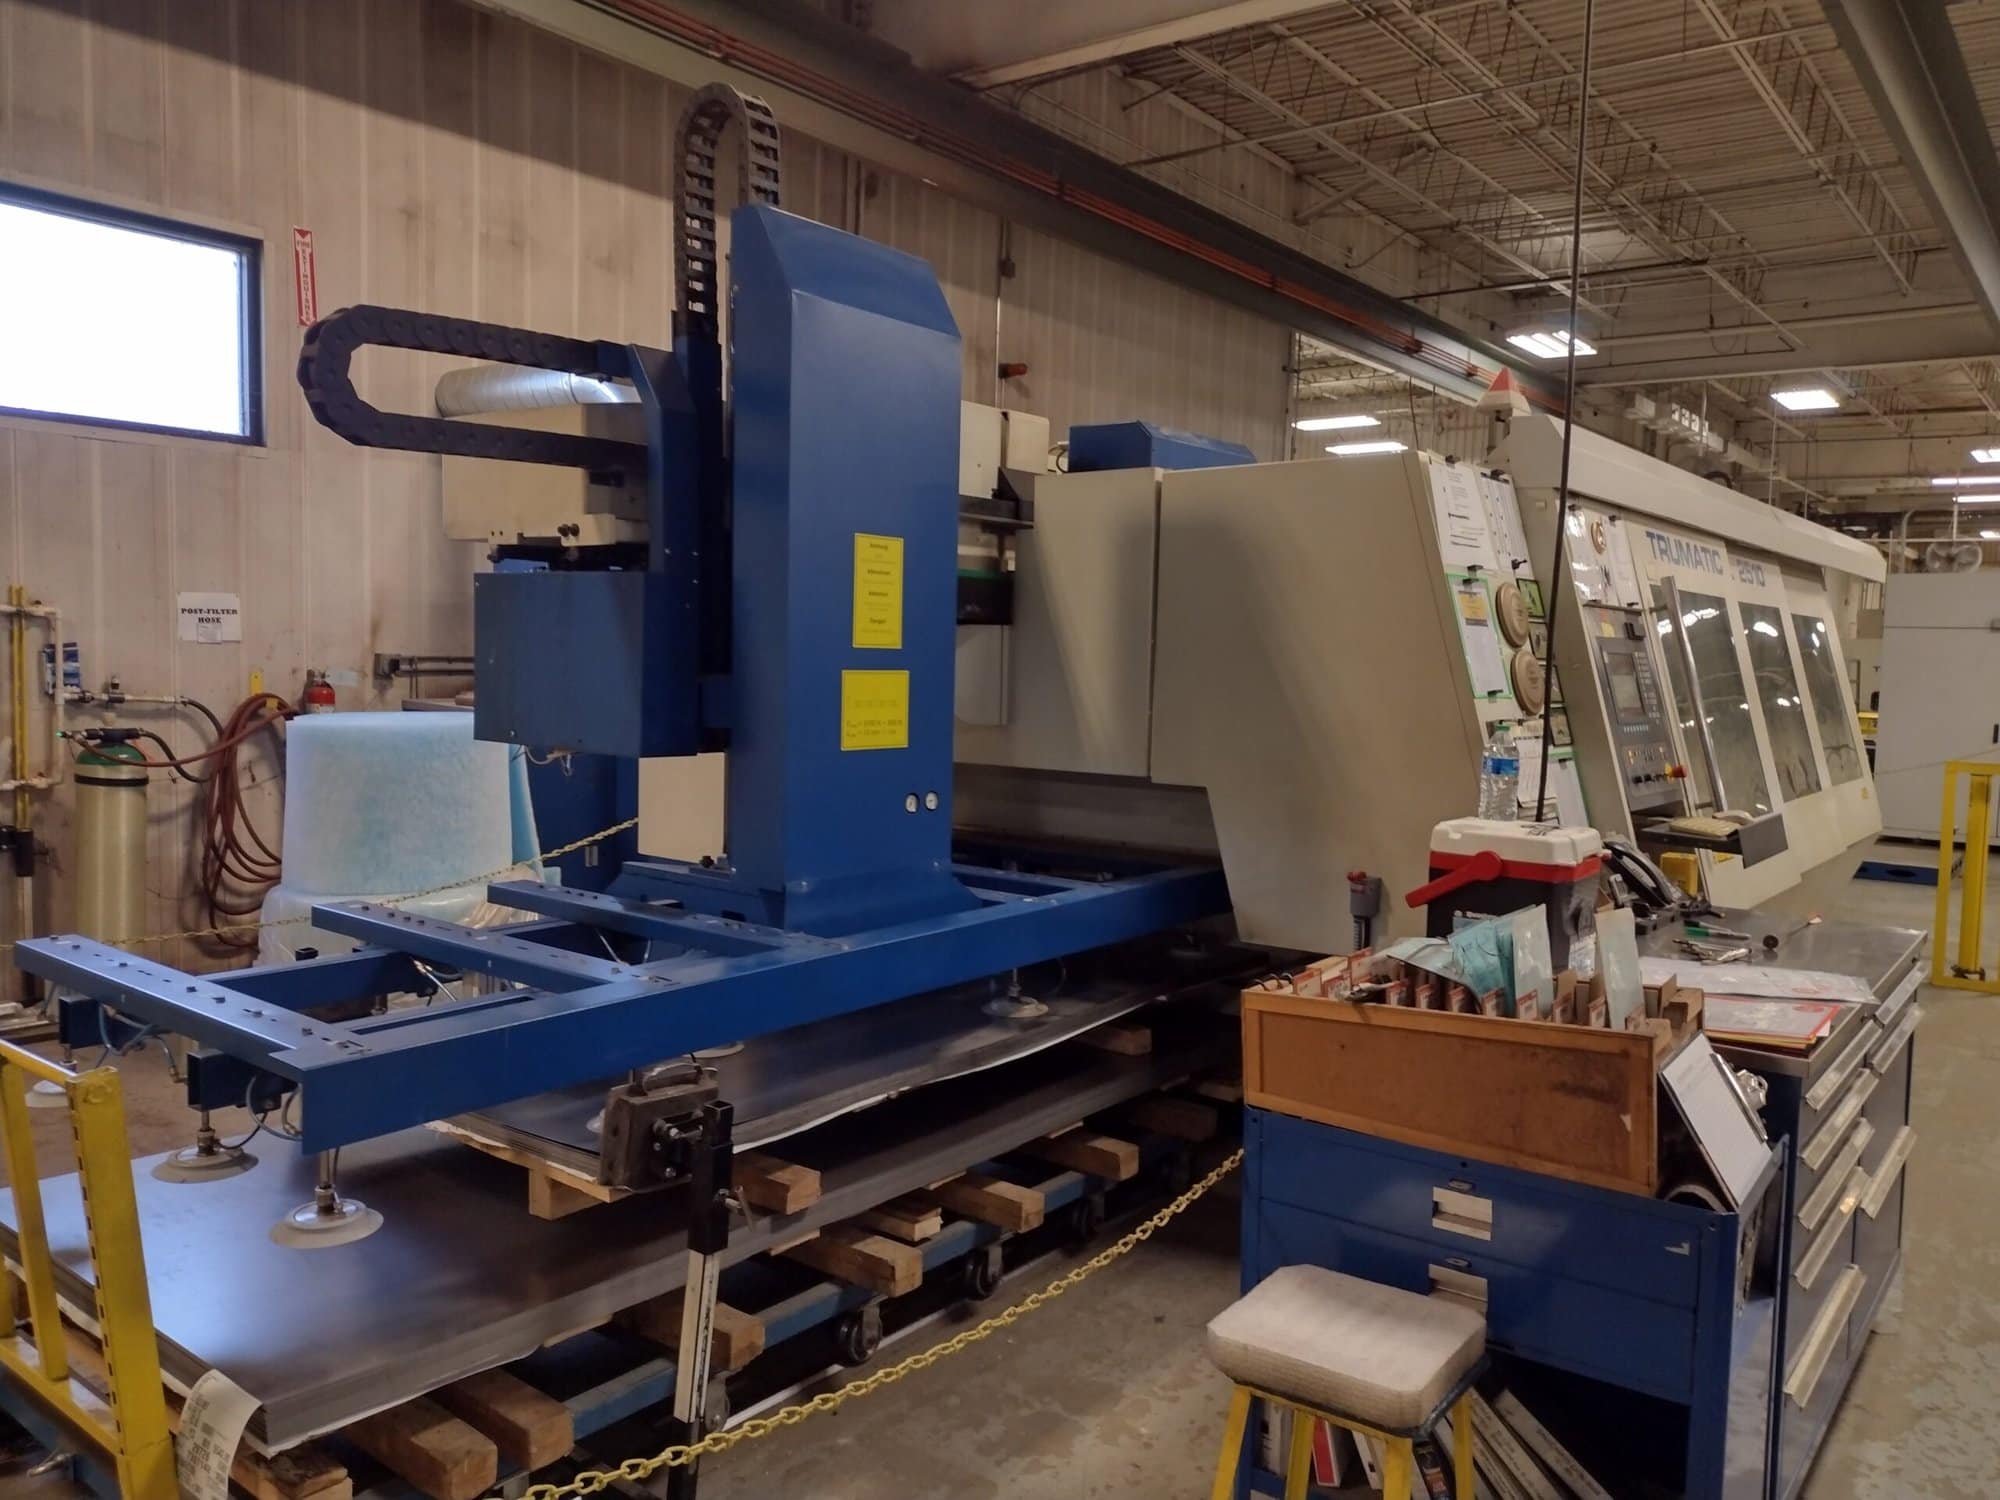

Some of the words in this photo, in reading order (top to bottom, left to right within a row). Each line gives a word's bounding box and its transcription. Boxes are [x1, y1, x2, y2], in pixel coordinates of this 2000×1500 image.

[1646, 530, 1723, 576] TRUMATIC
[181, 607, 238, 615] POST-FILTER
[198, 616, 221, 624] HOSE
